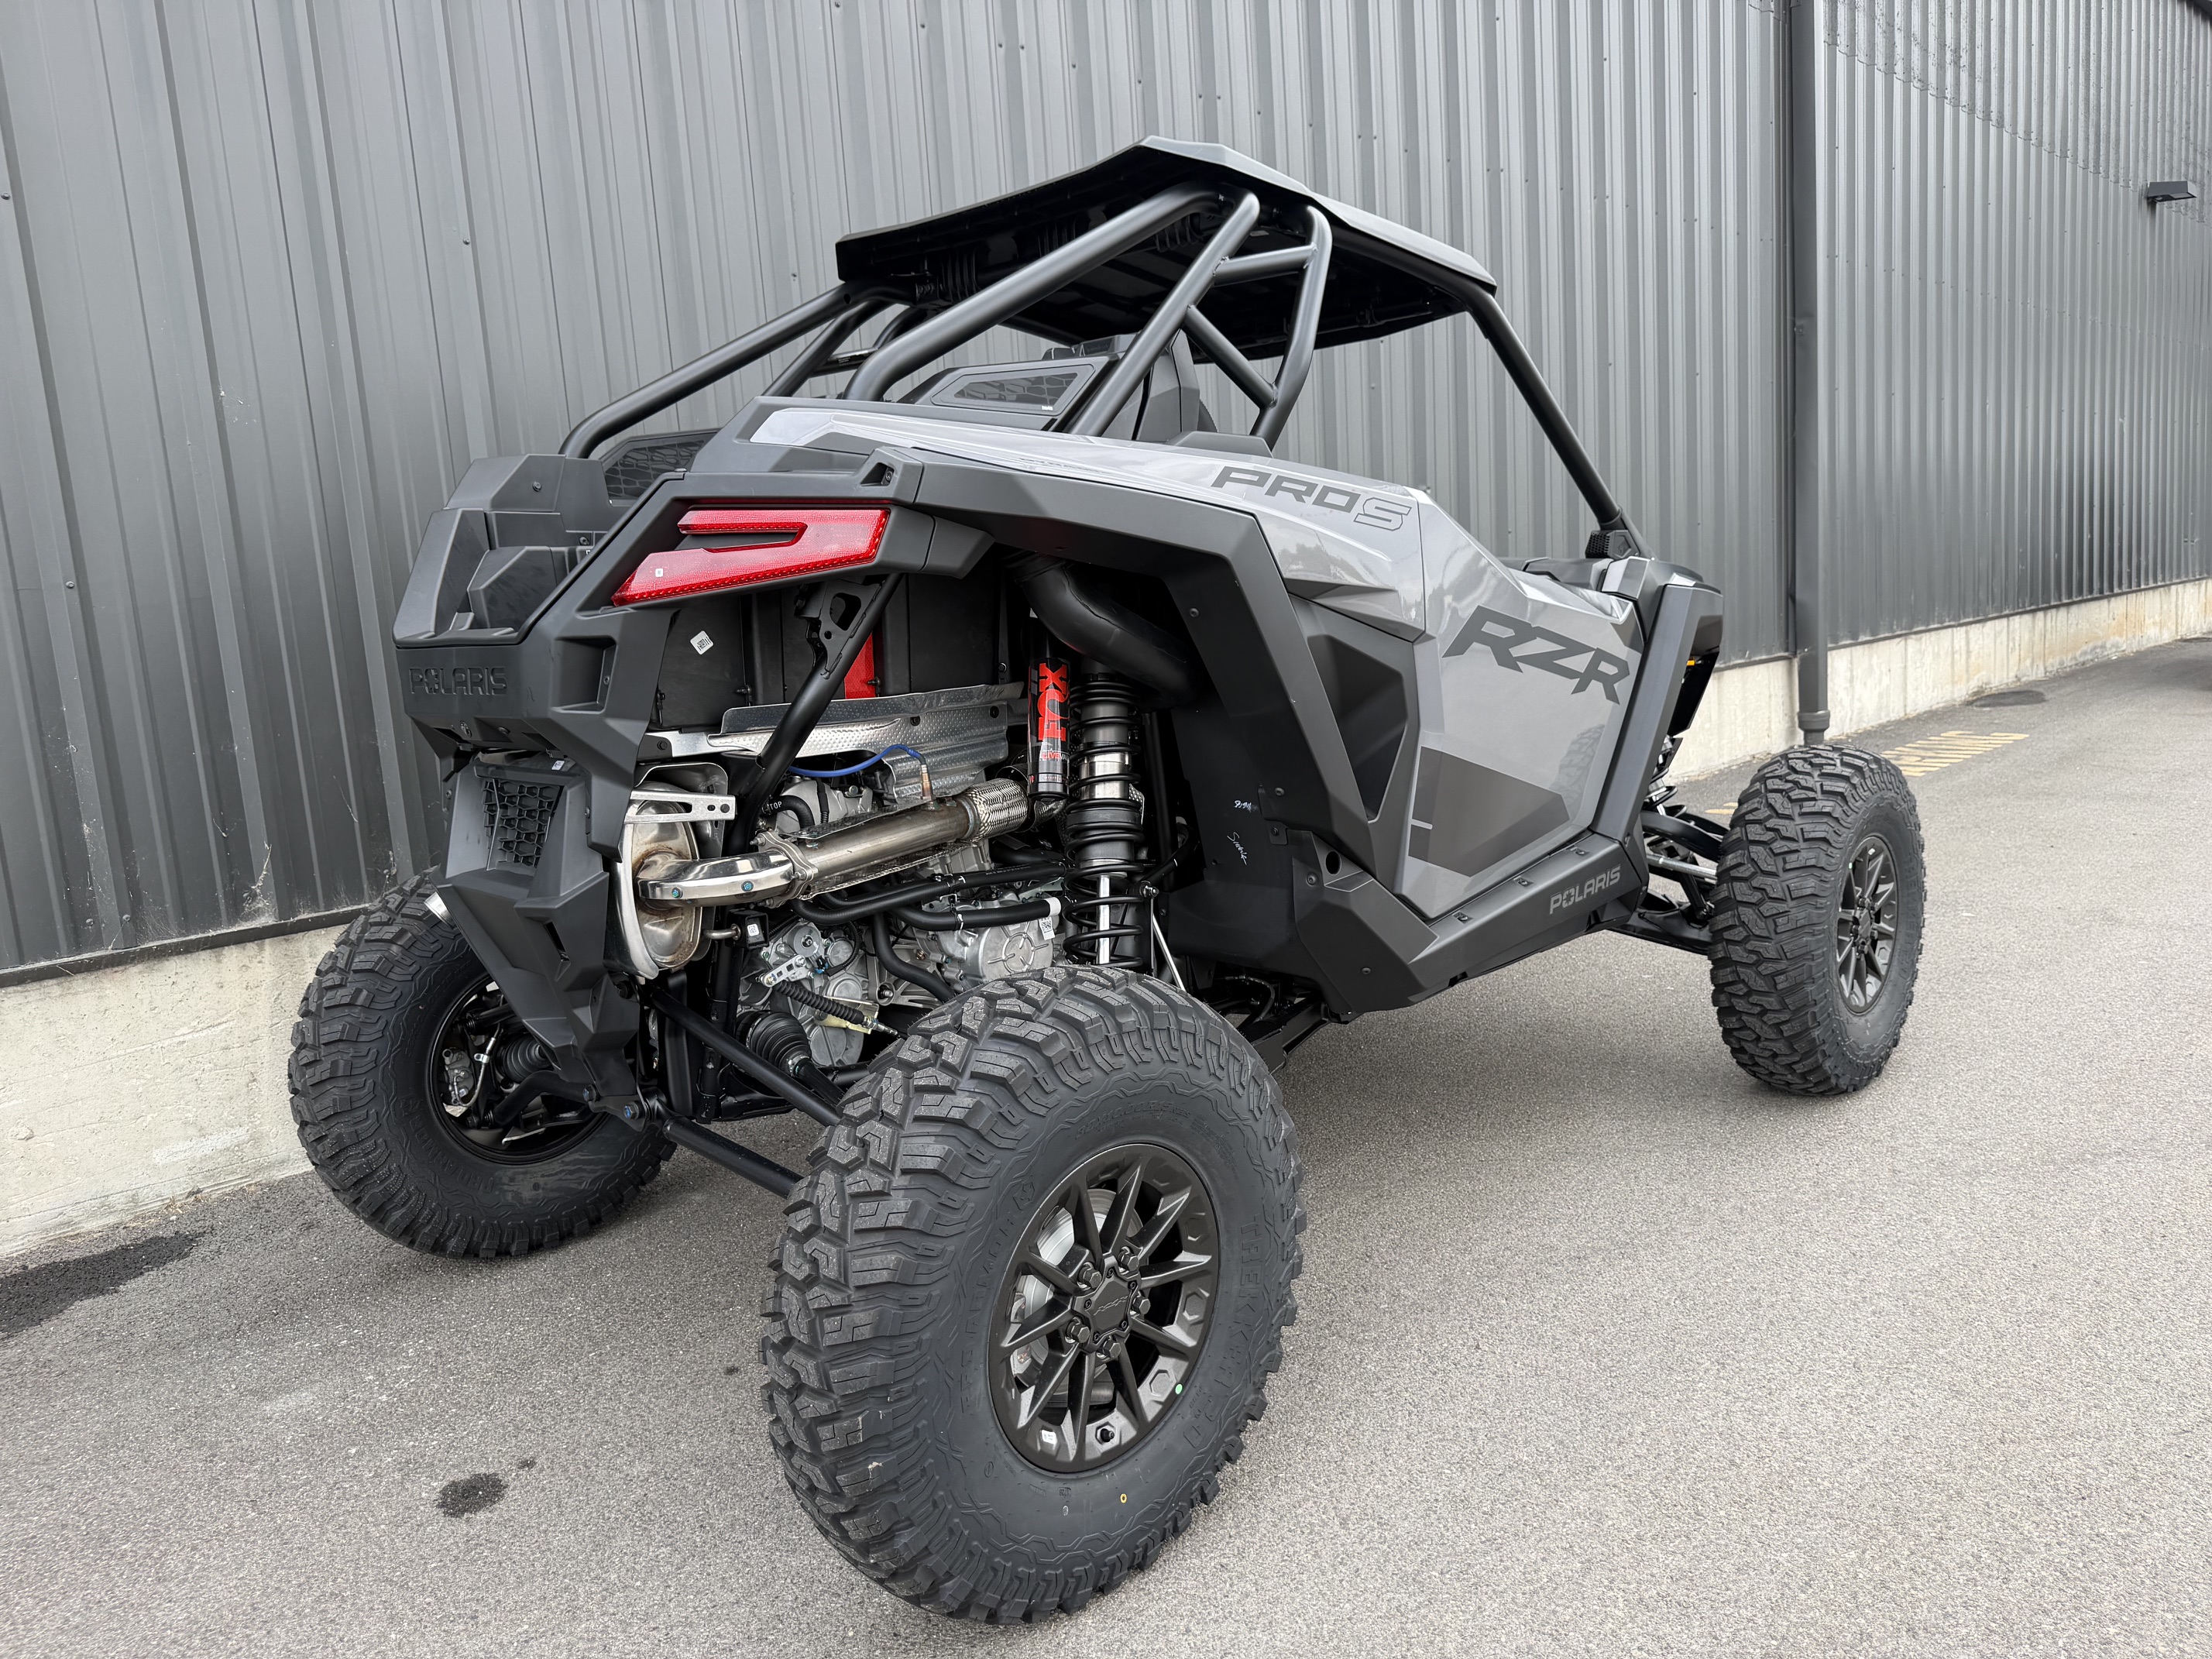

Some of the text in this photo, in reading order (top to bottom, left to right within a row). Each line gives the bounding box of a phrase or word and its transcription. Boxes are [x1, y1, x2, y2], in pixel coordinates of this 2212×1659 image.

[1211, 466, 1412, 531] PRO S
[409, 667, 508, 696] POLARIS
[1441, 604, 1630, 705] RZR
[1037, 663, 1070, 742] FOX
[1550, 864, 1621, 915] POLARIS
[1214, 1212, 1266, 1389] TREKKER
